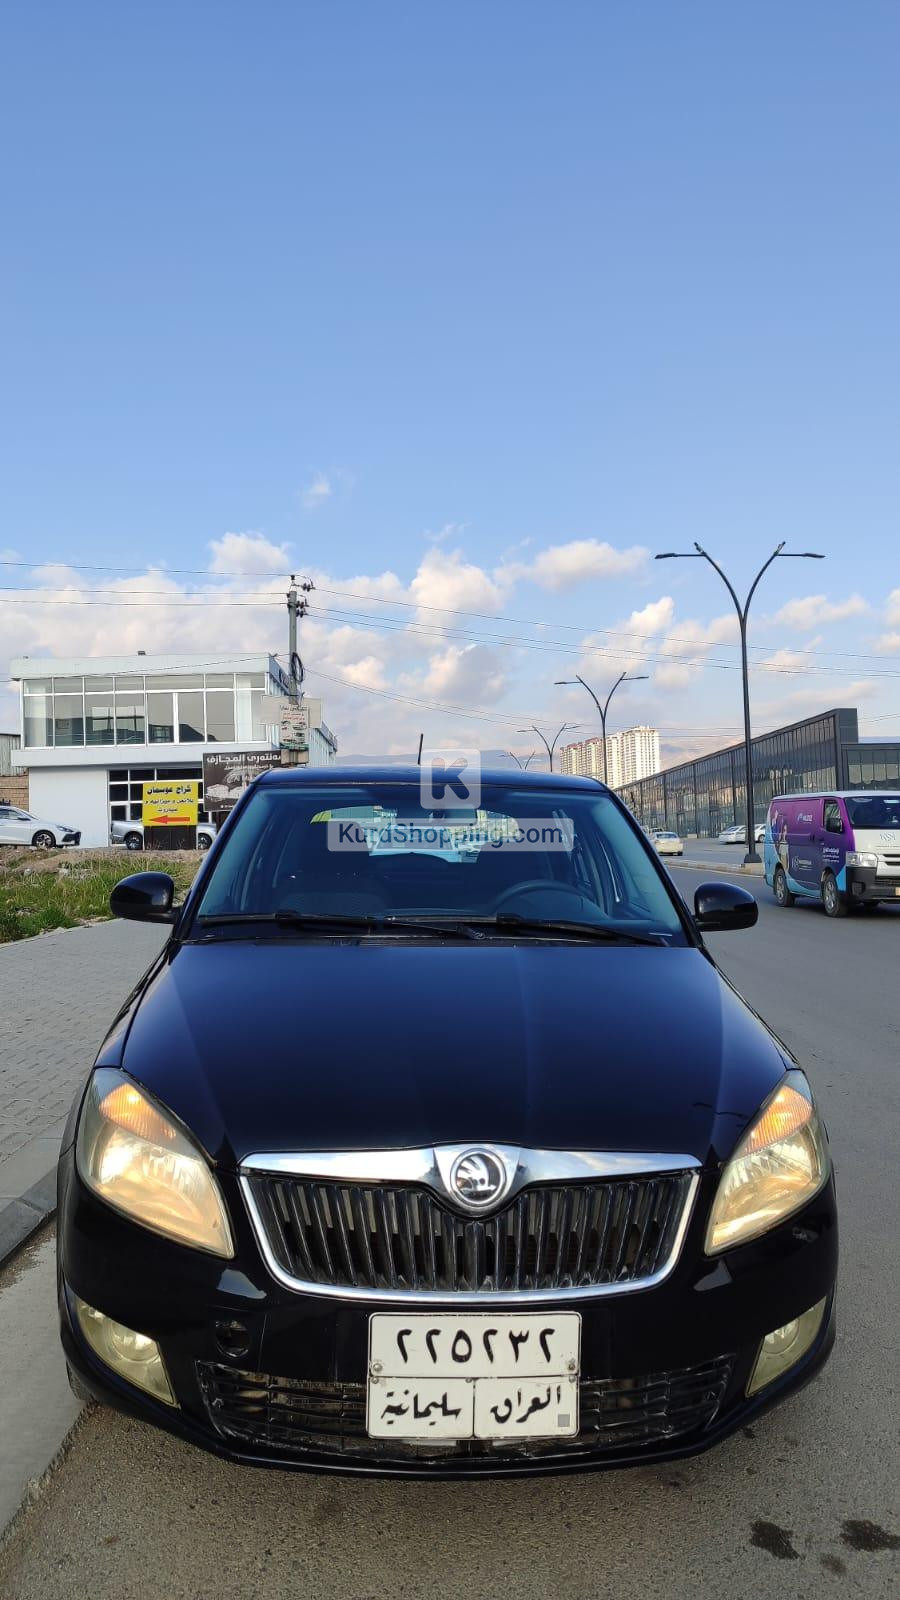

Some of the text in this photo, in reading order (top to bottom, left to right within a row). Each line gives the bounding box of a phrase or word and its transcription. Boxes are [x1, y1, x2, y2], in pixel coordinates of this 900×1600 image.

[396, 1328, 556, 1365] ٢٢٥٢٣٢
[380, 1389, 463, 1426] سليمانية
[489, 1384, 562, 1424] العراق
